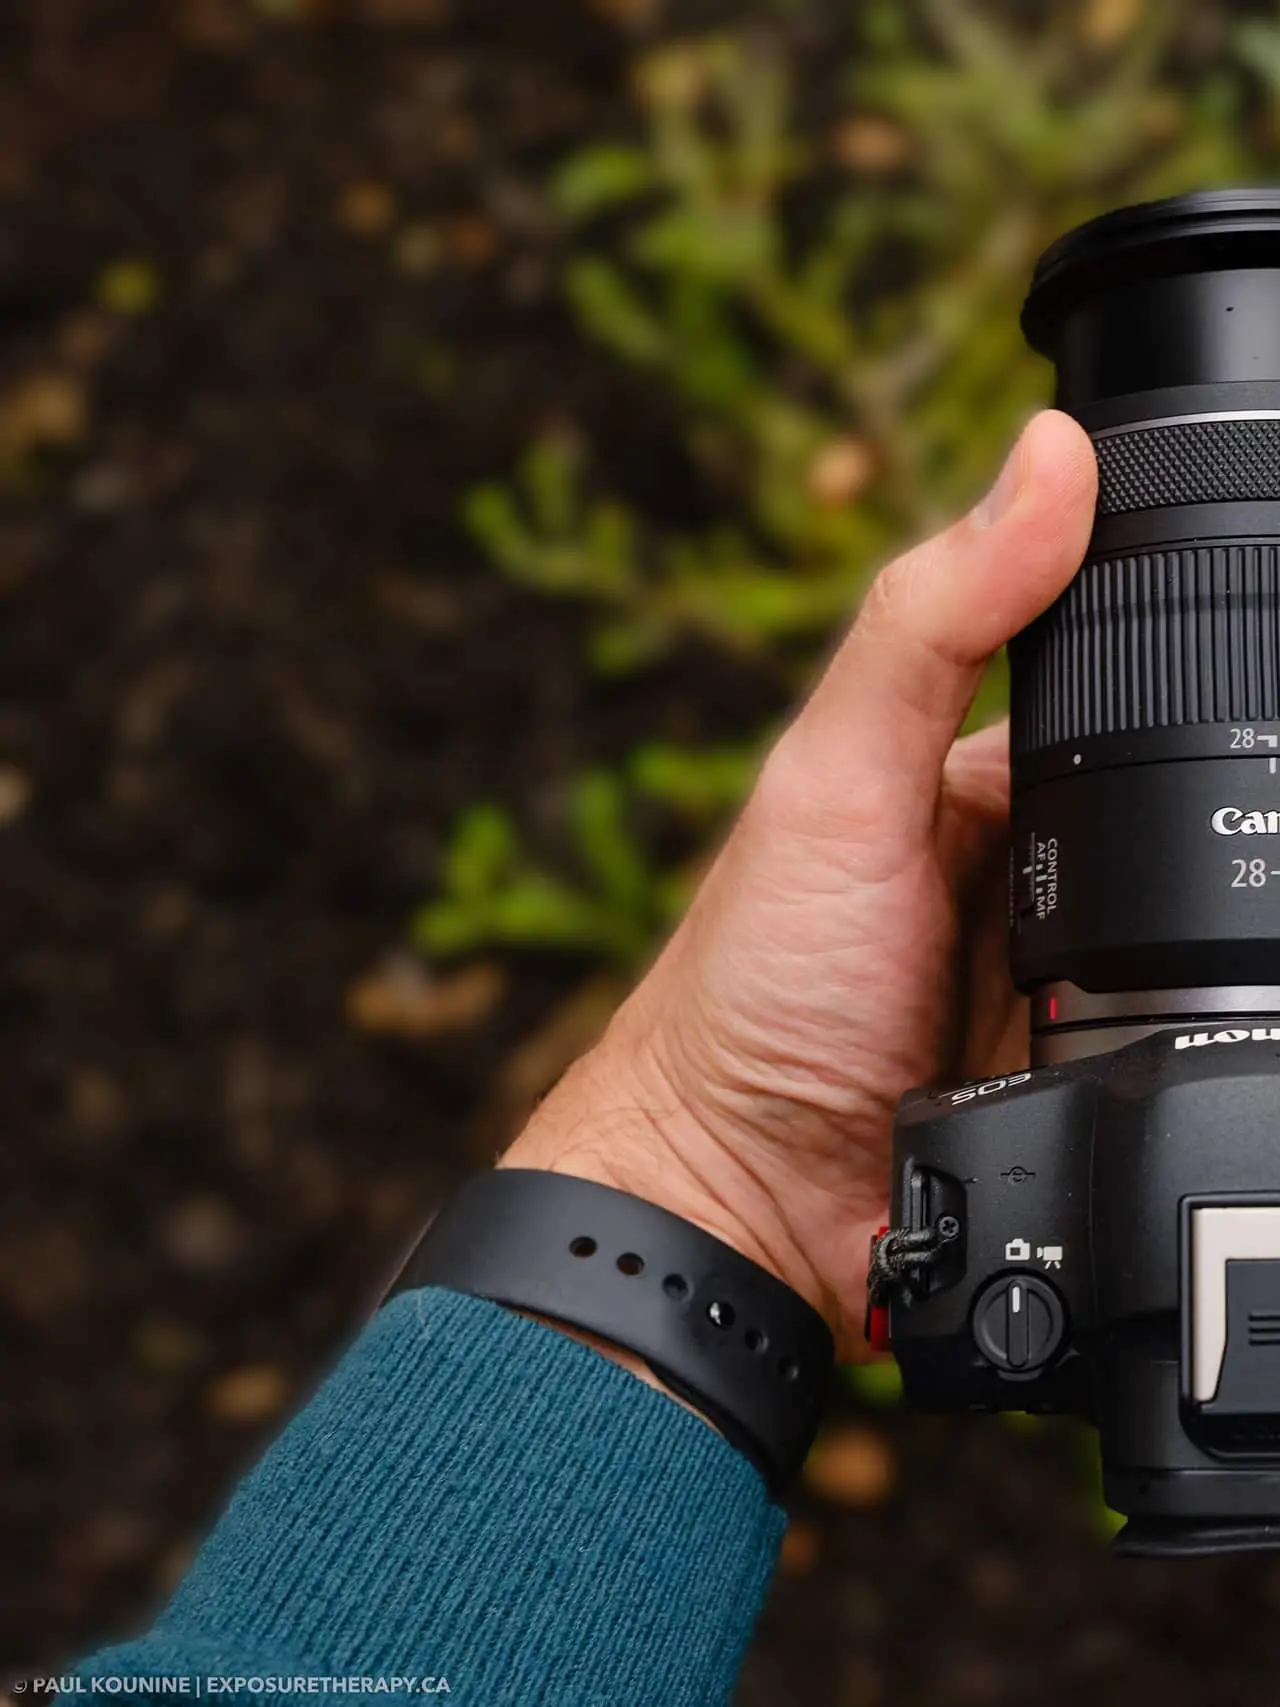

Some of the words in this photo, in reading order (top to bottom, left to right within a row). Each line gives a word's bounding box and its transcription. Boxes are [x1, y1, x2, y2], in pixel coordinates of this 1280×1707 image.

[1230, 728, 1255, 748] 28
[1036, 841, 1046, 861] AF
[1047, 837, 1058, 915] CONTROL
[1036, 895, 1046, 920] MF
[951, 1072, 1032, 1106] EOS
